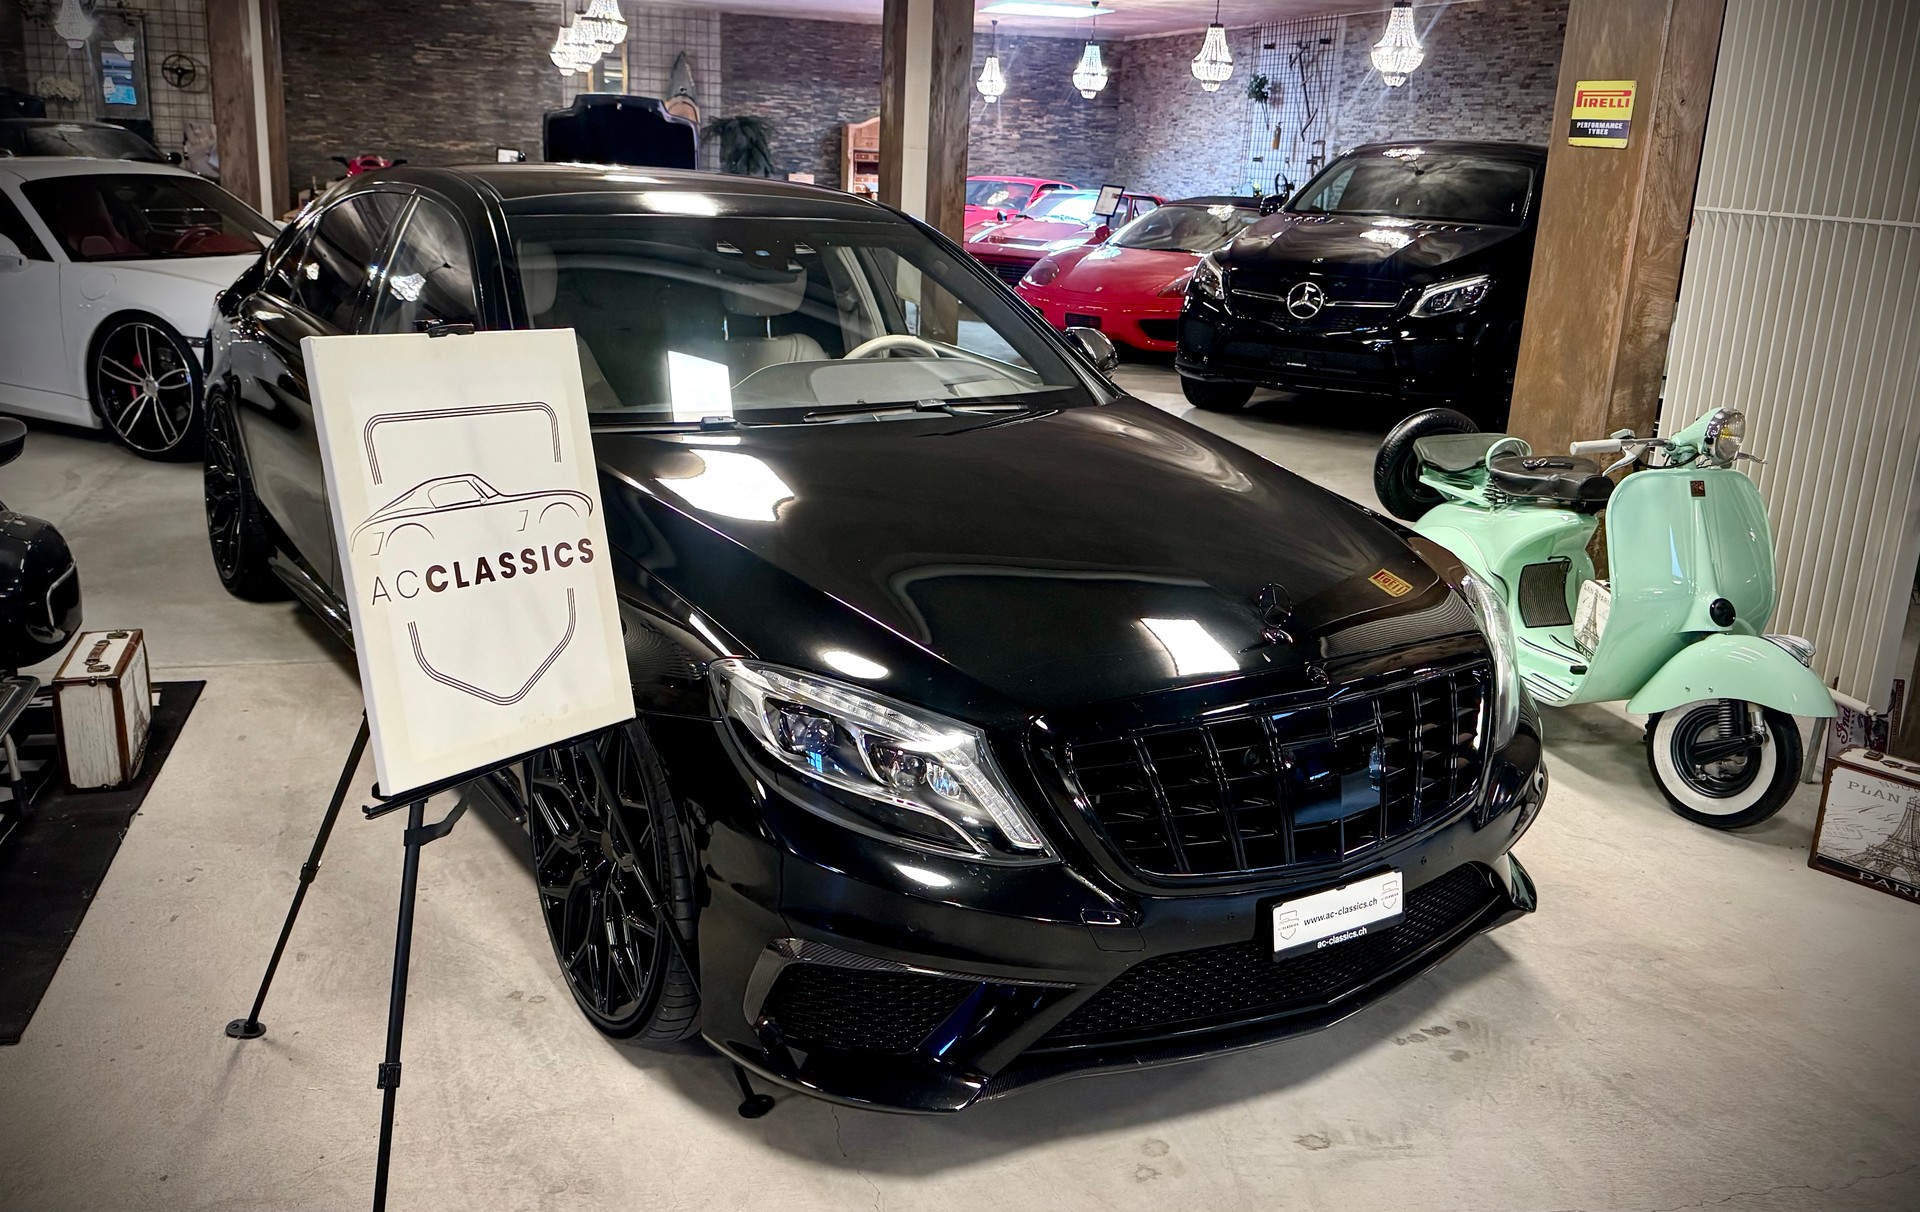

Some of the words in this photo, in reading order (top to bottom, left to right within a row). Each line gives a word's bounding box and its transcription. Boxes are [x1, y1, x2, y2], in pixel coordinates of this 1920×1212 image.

[1576, 90, 1632, 108] PIRELLI
[1576, 121, 1624, 130] PERFORMANCE
[1836, 704, 1850, 744] Ind
[1847, 780, 1902, 804] PLAN
[1859, 871, 1920, 898] PARI
[1303, 897, 1378, 926] www.ac-classics.ch
[1316, 926, 1368, 949] ac-classics.ch
